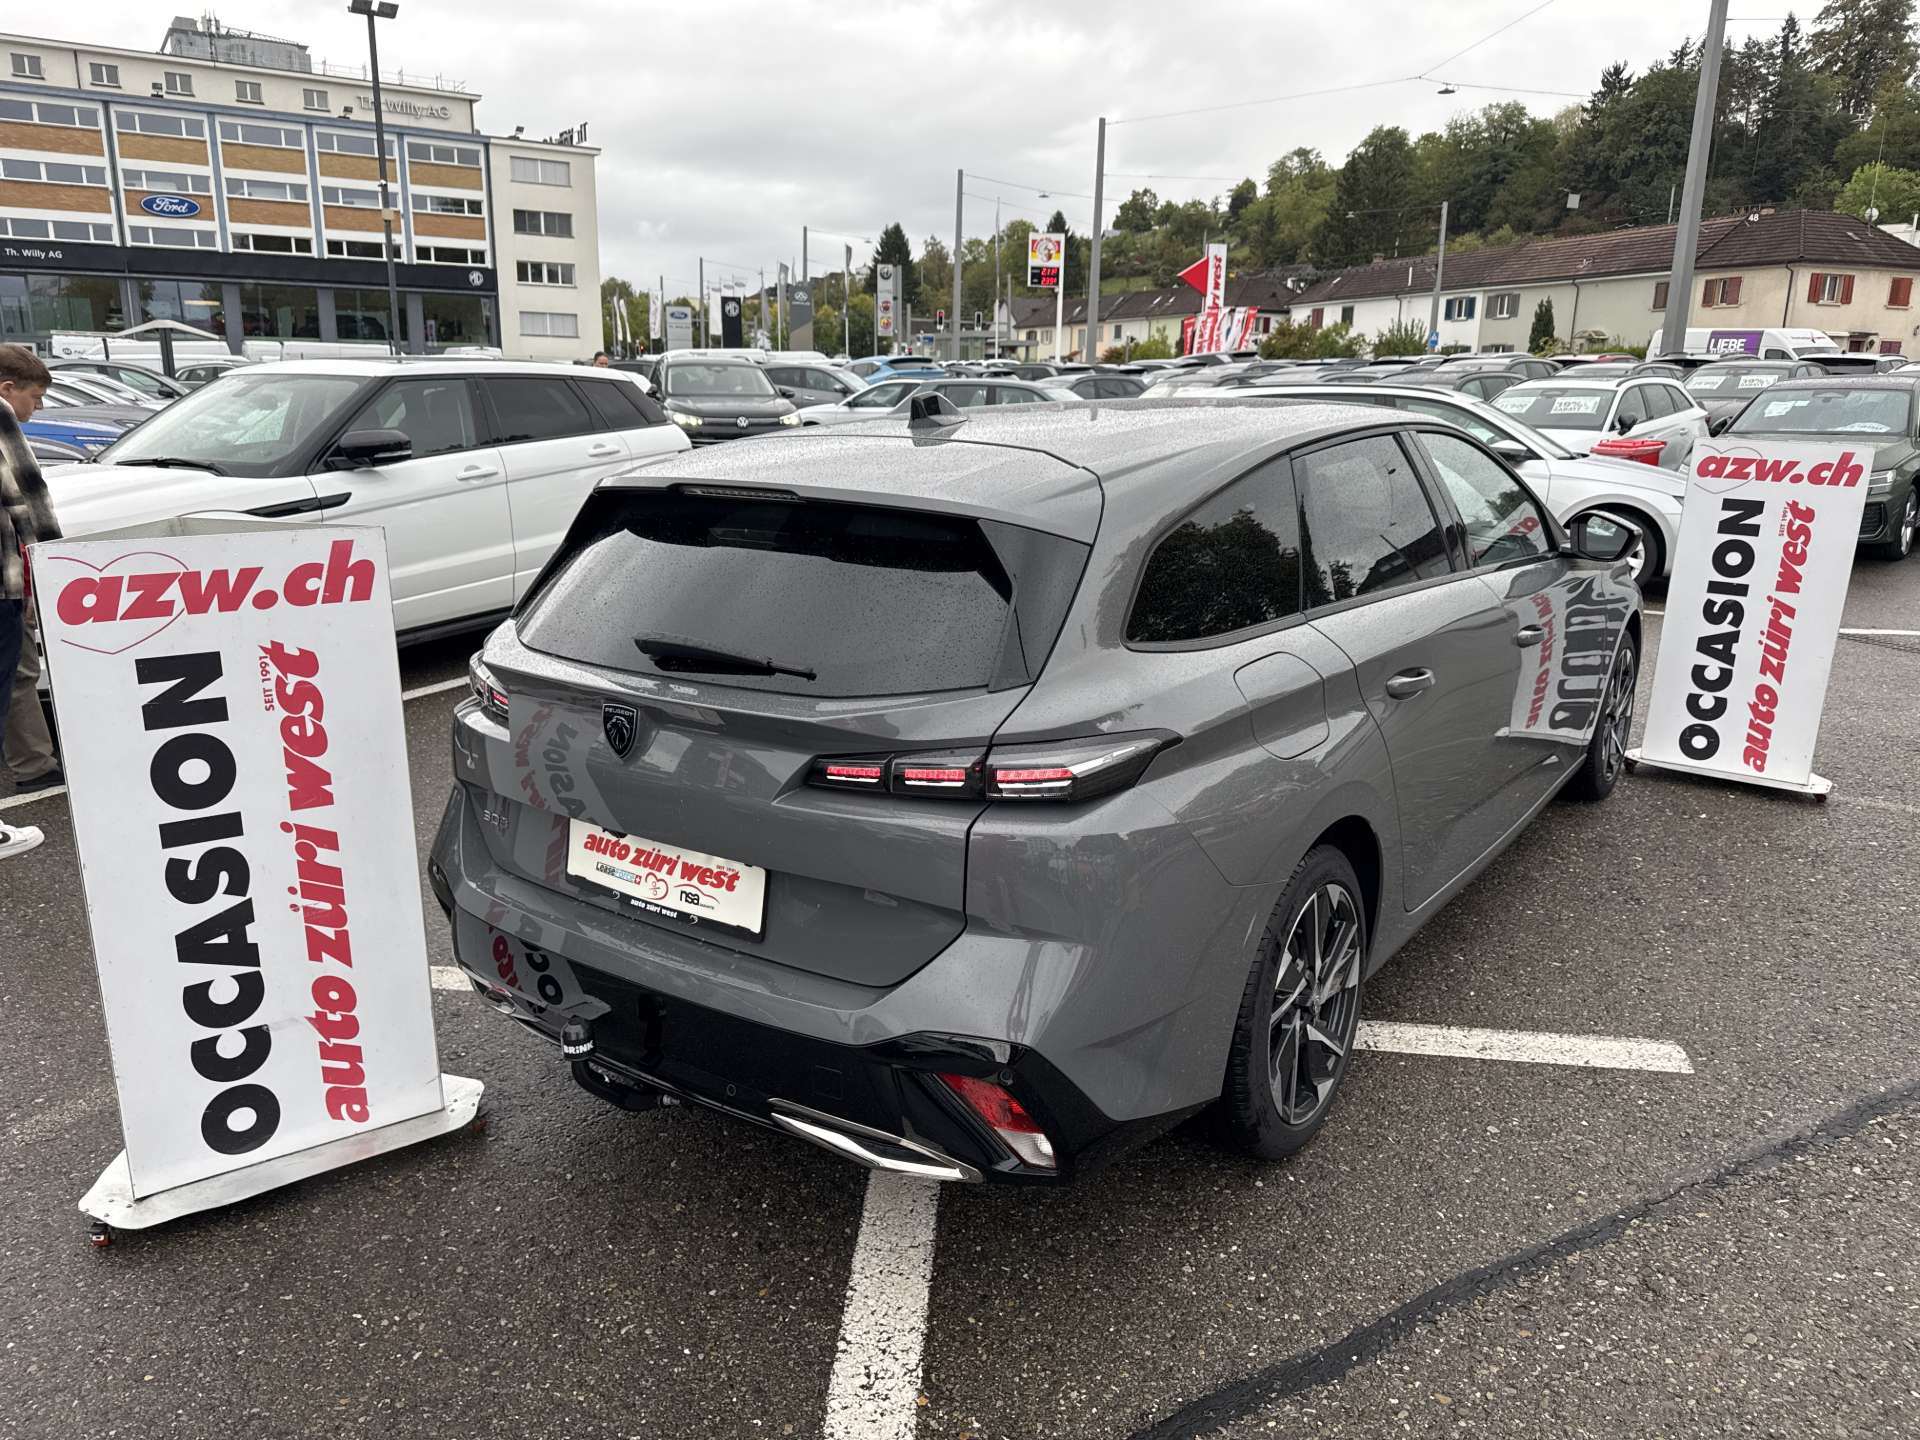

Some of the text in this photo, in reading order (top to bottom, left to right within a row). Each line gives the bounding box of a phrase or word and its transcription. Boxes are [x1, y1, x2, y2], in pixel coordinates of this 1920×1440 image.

[387, 101, 424, 119] Willy
[427, 105, 452, 119] AG
[152, 197, 188, 213] Ford
[1748, 213, 1759, 221] 48
[5, 247, 63, 259] Th. Willy AG
[724, 301, 740, 317] MG
[1709, 339, 1746, 351] LIEBE
[1696, 452, 1864, 487] azw.ch
[57, 540, 376, 625] azw.ch
[1678, 498, 1765, 760] OCCASION
[1743, 500, 1816, 773] auto züri west
[259, 656, 275, 711] SEIT 1991
[604, 707, 634, 717] PEUGEOT
[584, 832, 741, 892] auto züri west
[258, 640, 370, 1123] auto züri west
[135, 651, 281, 1155] OCCASION
[630, 898, 645, 909] auto
[661, 908, 678, 919] west
[680, 890, 700, 906] nsa
